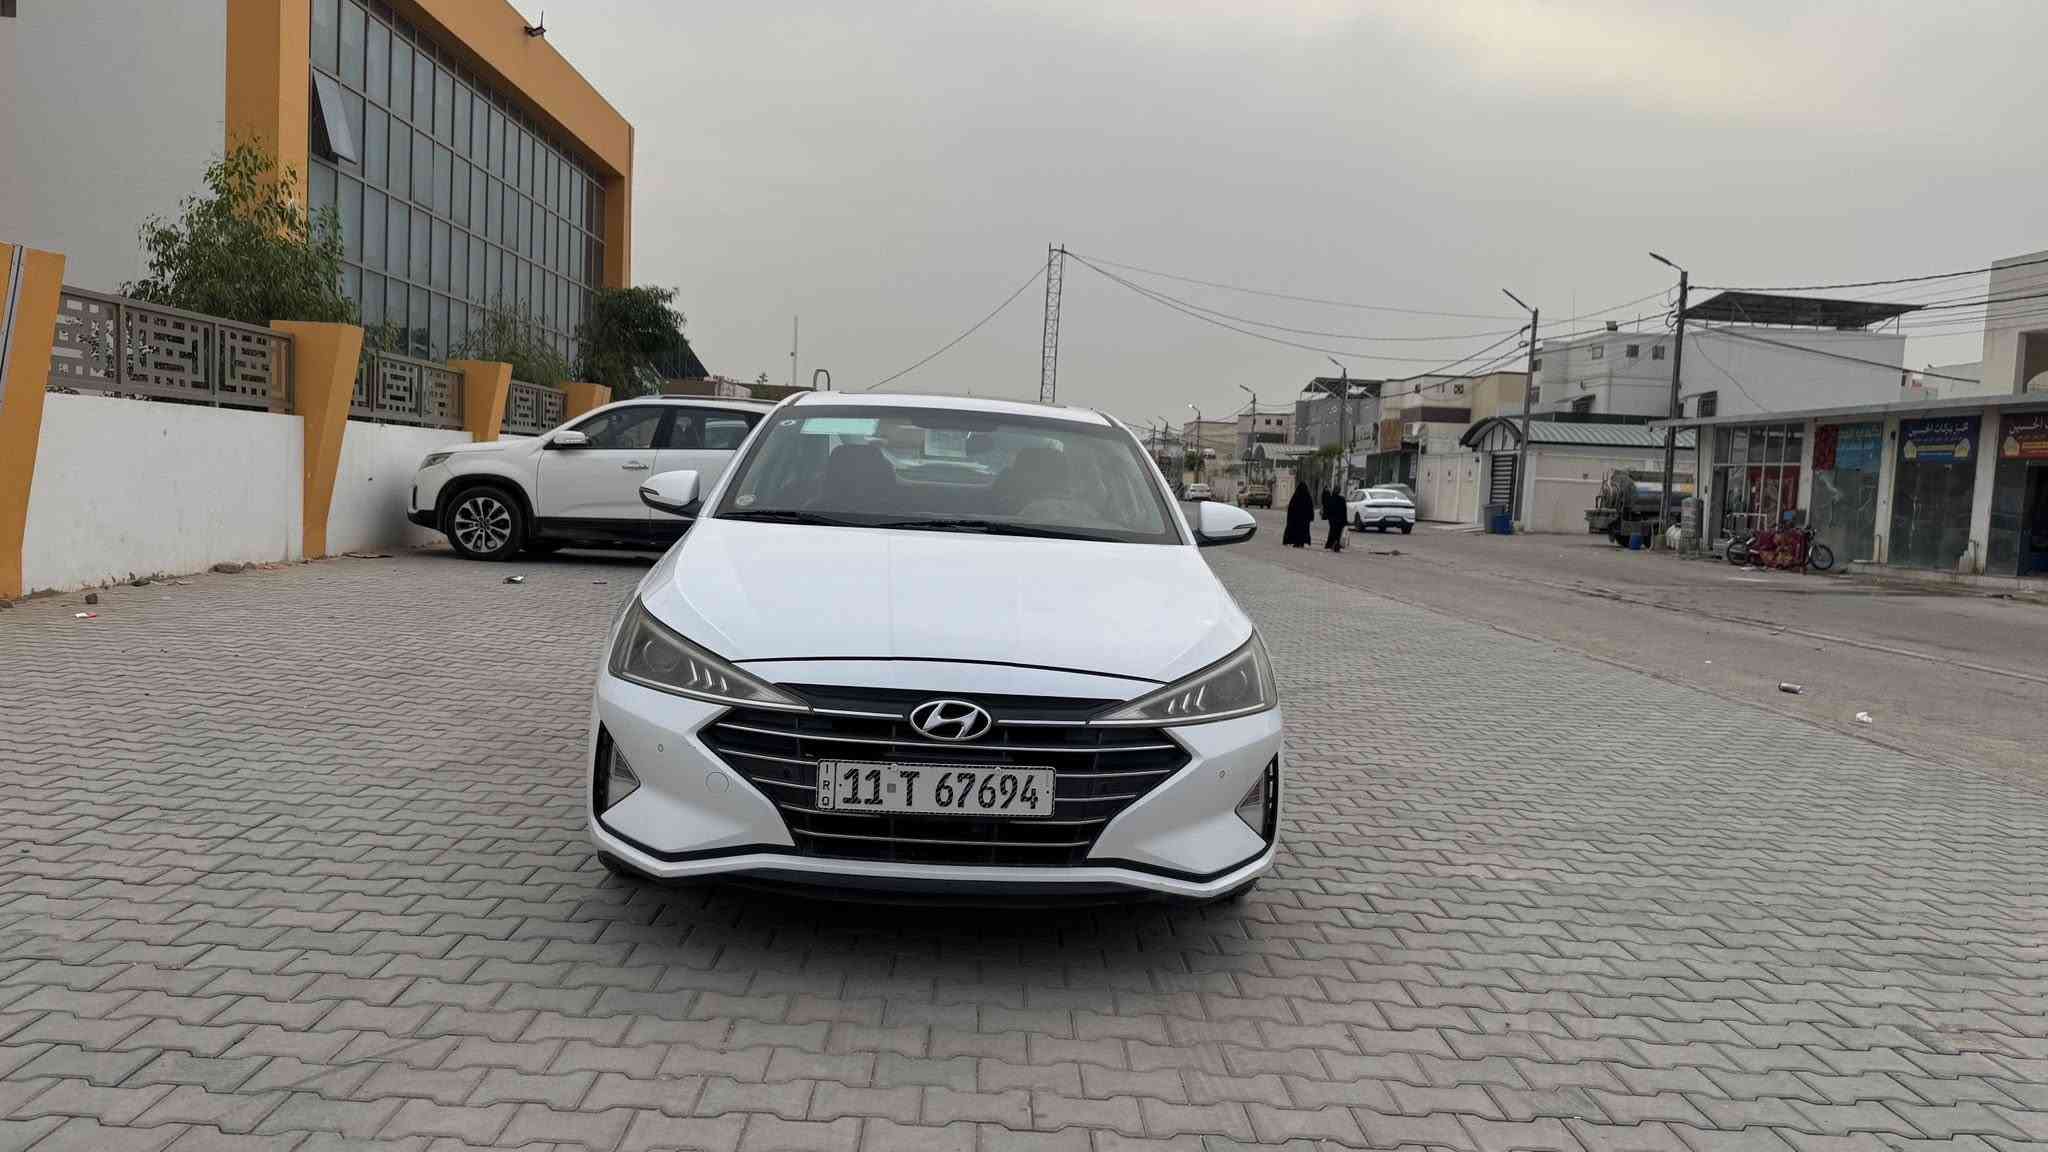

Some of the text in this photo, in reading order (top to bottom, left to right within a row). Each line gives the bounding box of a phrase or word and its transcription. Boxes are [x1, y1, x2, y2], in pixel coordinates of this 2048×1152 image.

[842, 768, 1039, 809] 11 T 67694
